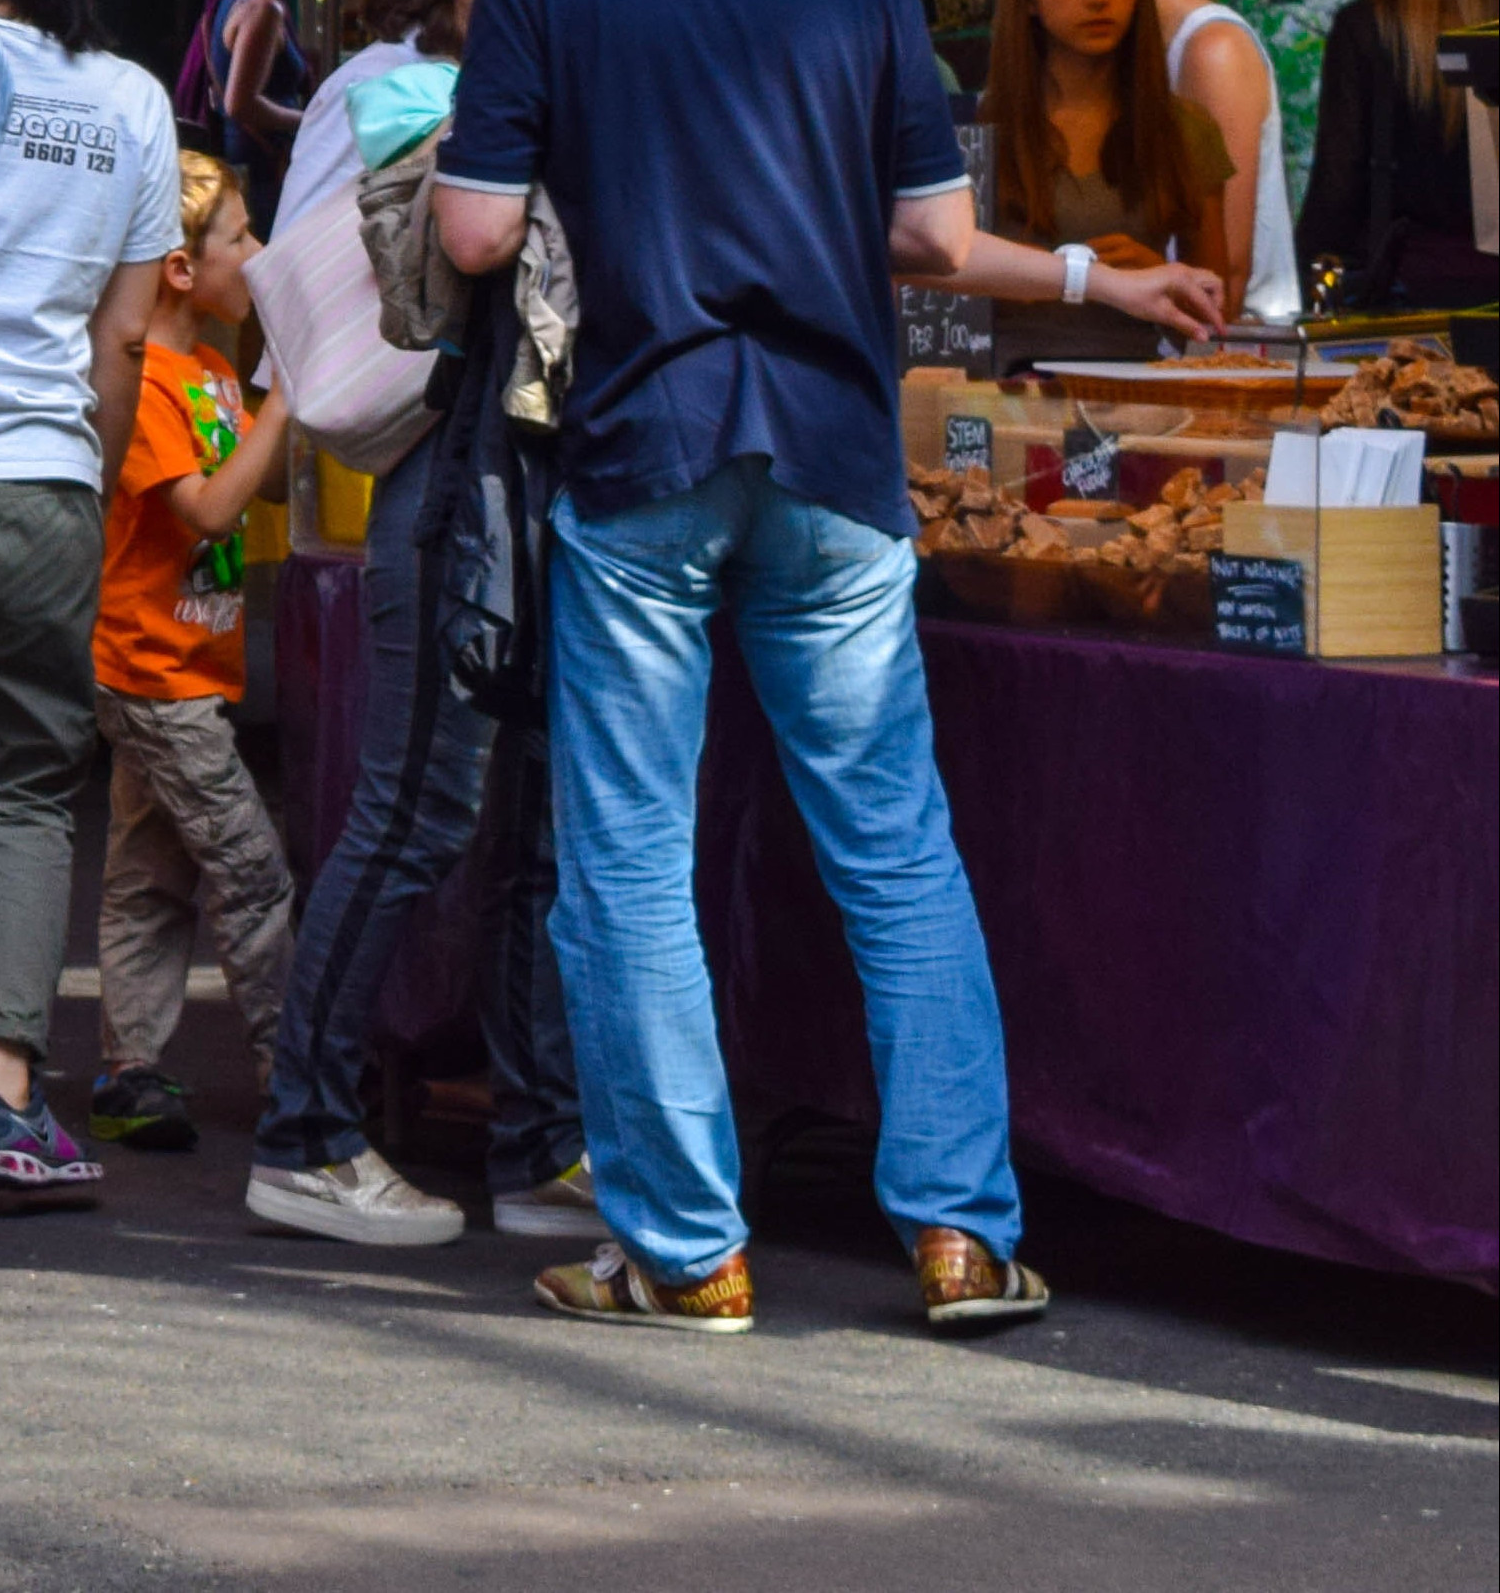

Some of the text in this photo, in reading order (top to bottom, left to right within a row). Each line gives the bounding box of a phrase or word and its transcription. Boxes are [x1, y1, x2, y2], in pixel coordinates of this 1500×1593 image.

[23, 140, 116, 174] 6603 129
[946, 418, 988, 449] STEM
